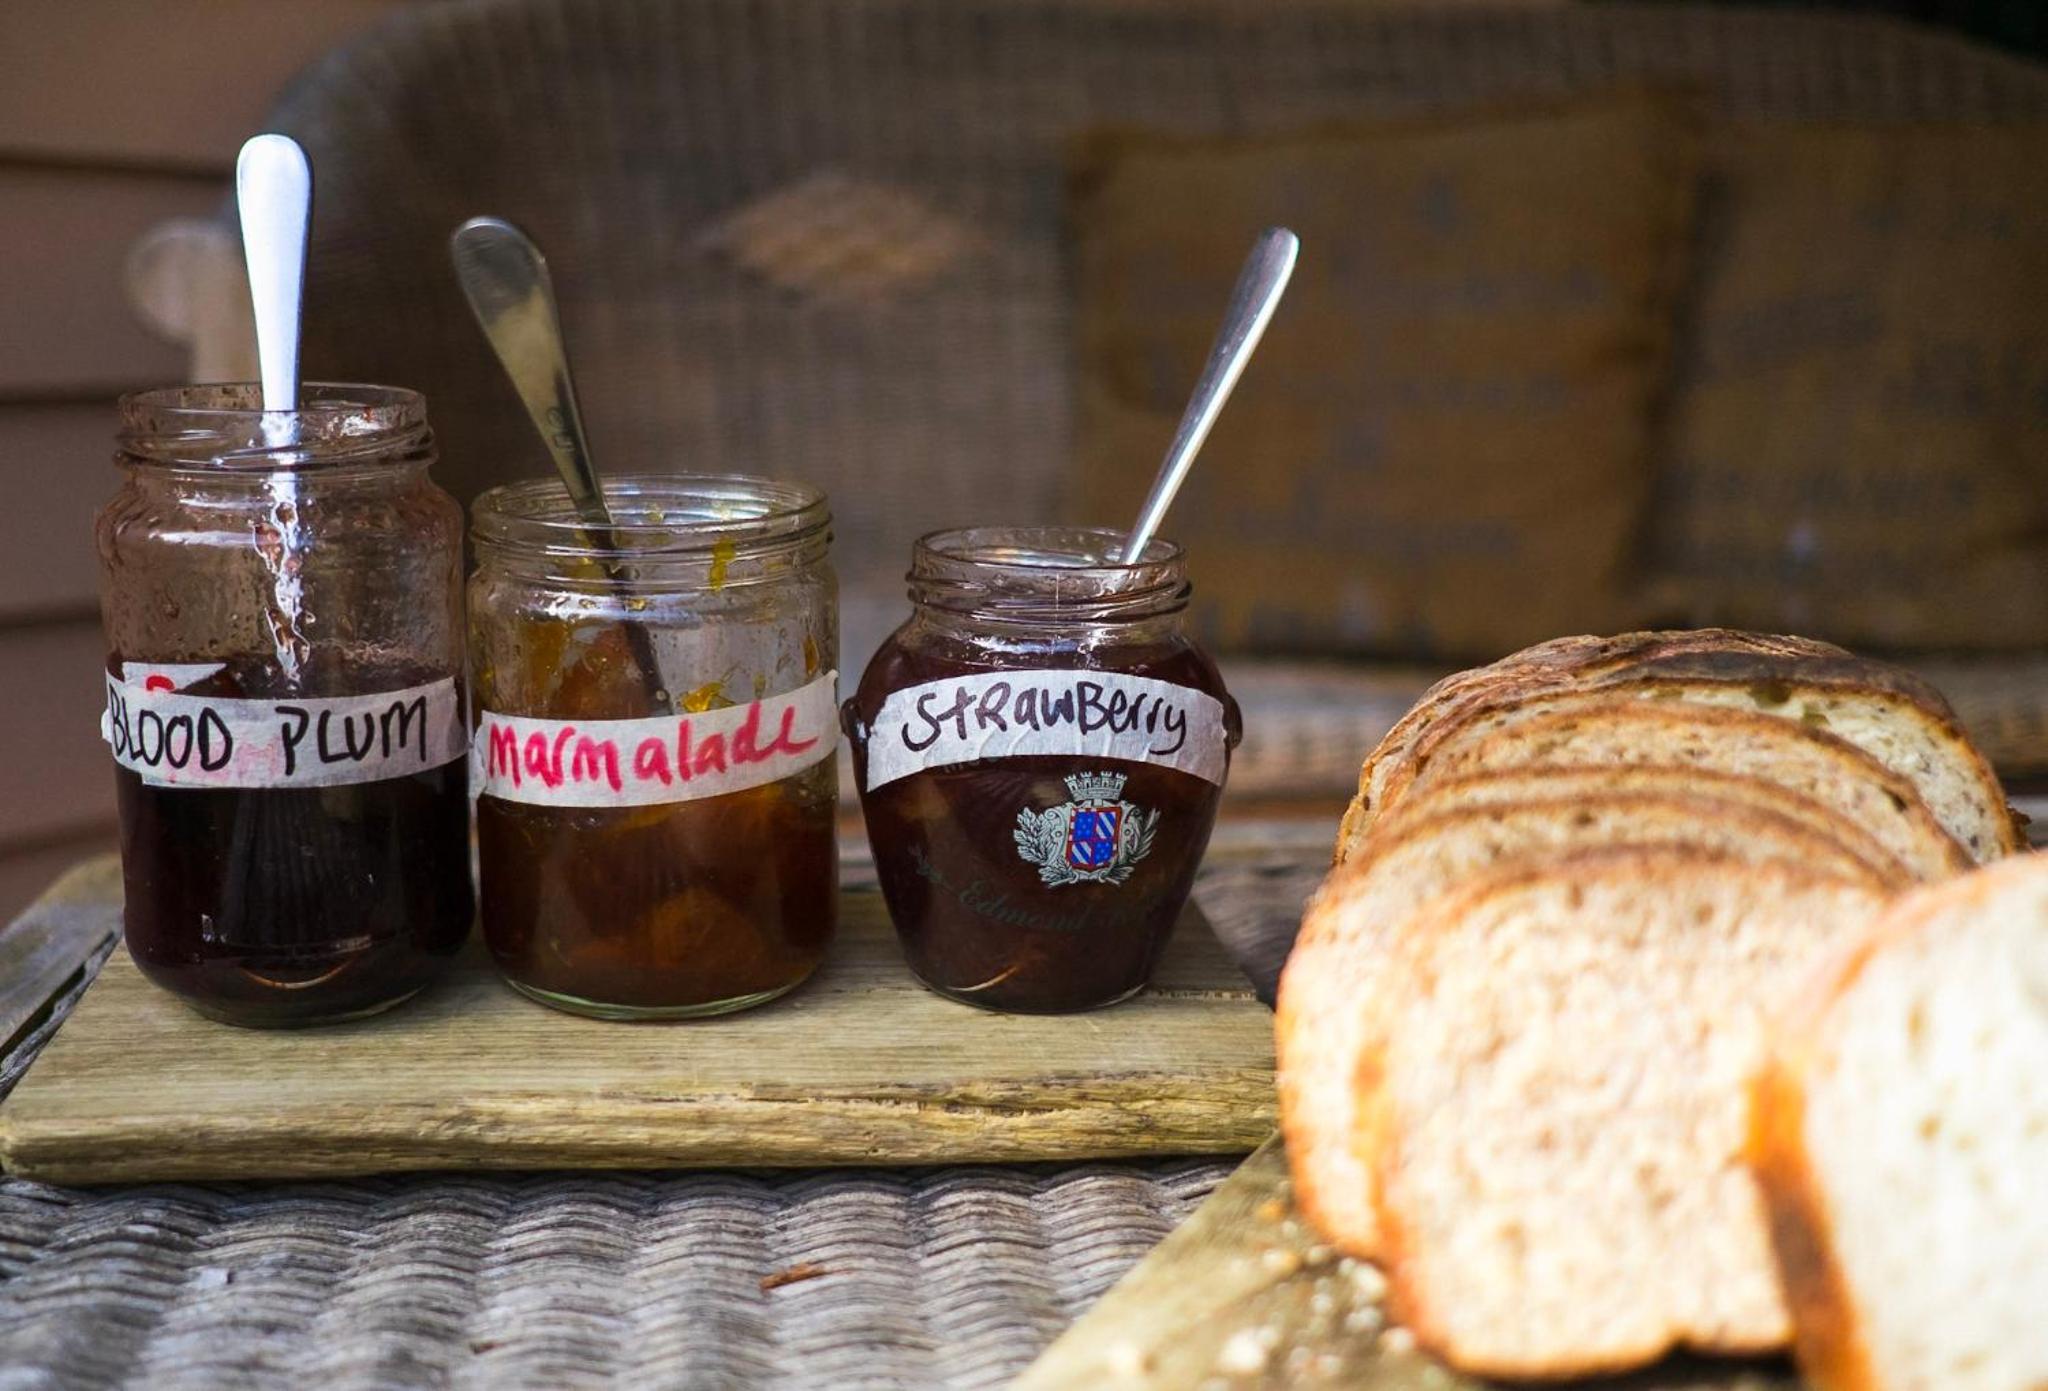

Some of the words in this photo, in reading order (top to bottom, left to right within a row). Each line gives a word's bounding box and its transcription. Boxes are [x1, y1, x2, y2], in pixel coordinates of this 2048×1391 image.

[109, 683, 233, 771] BLOOD
[275, 696, 427, 776] PLUM
[488, 699, 818, 792] Marmalade
